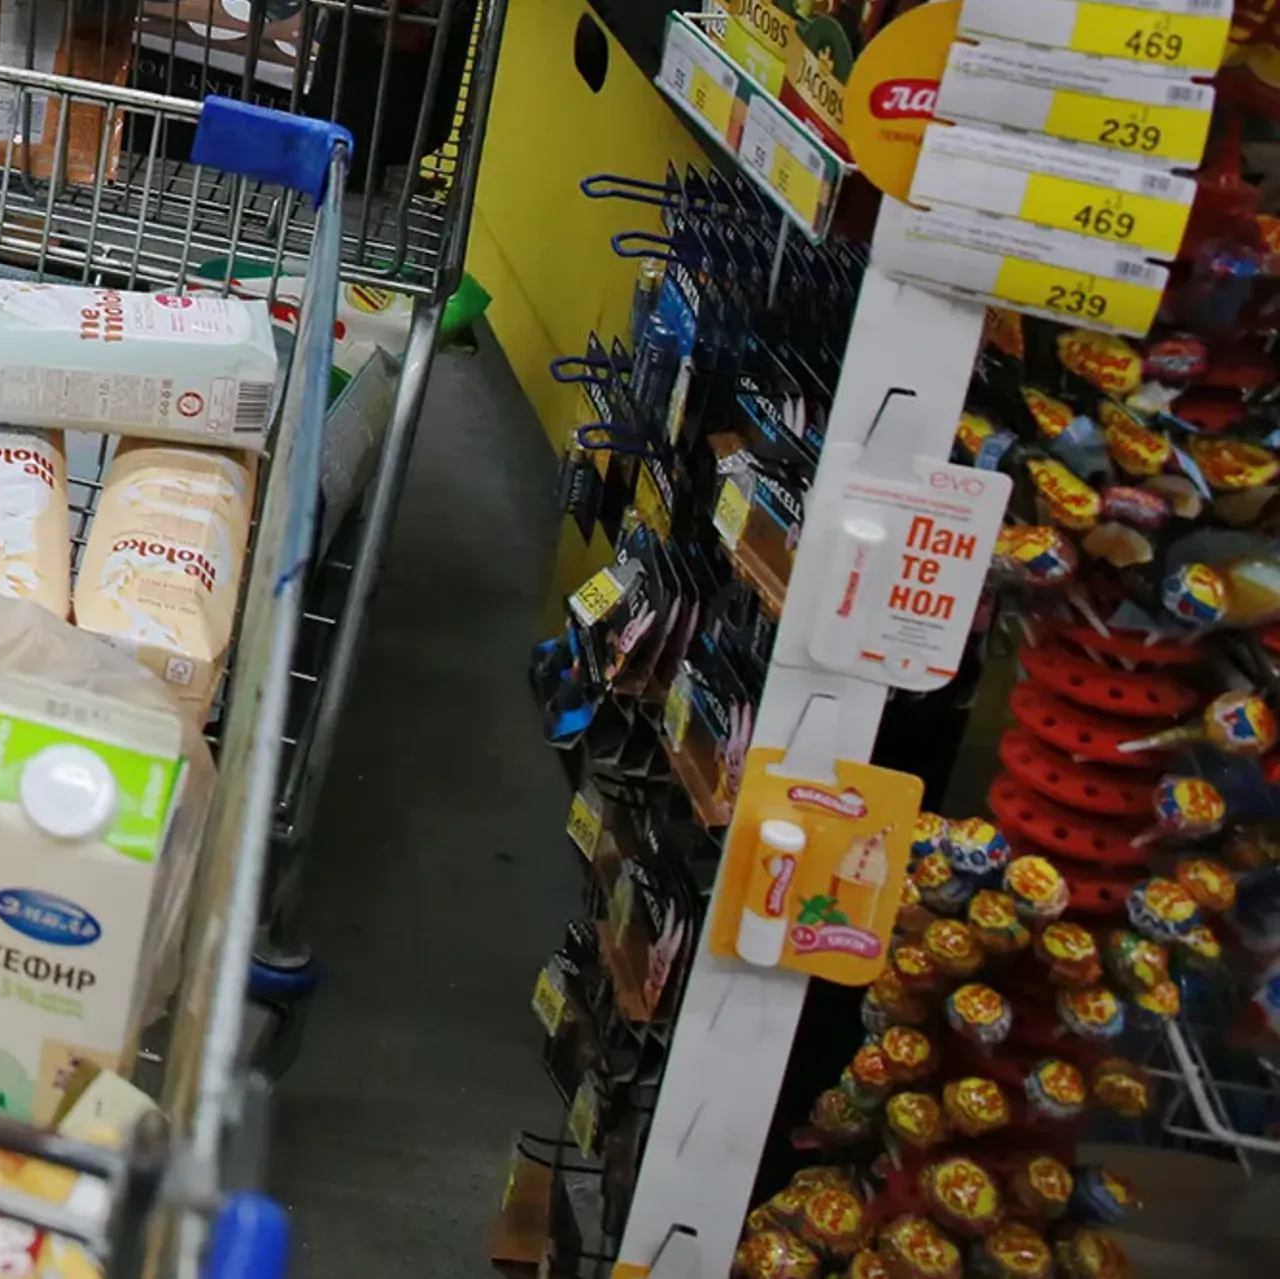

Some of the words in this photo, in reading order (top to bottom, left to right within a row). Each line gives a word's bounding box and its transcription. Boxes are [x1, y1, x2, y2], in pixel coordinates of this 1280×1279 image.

[1124, 29, 1183, 61] 469
[1098, 119, 1161, 152] 239
[1072, 205, 1135, 238] 469
[1045, 287, 1107, 319] 239
[80, 307, 100, 340] ne
[6, 461, 55, 491] ne
[929, 471, 986, 497] evo
[905, 516, 978, 559] Пан
[113, 538, 216, 579] moloko
[902, 554, 942, 585] те
[184, 563, 213, 593] ne
[888, 583, 956, 620] нол
